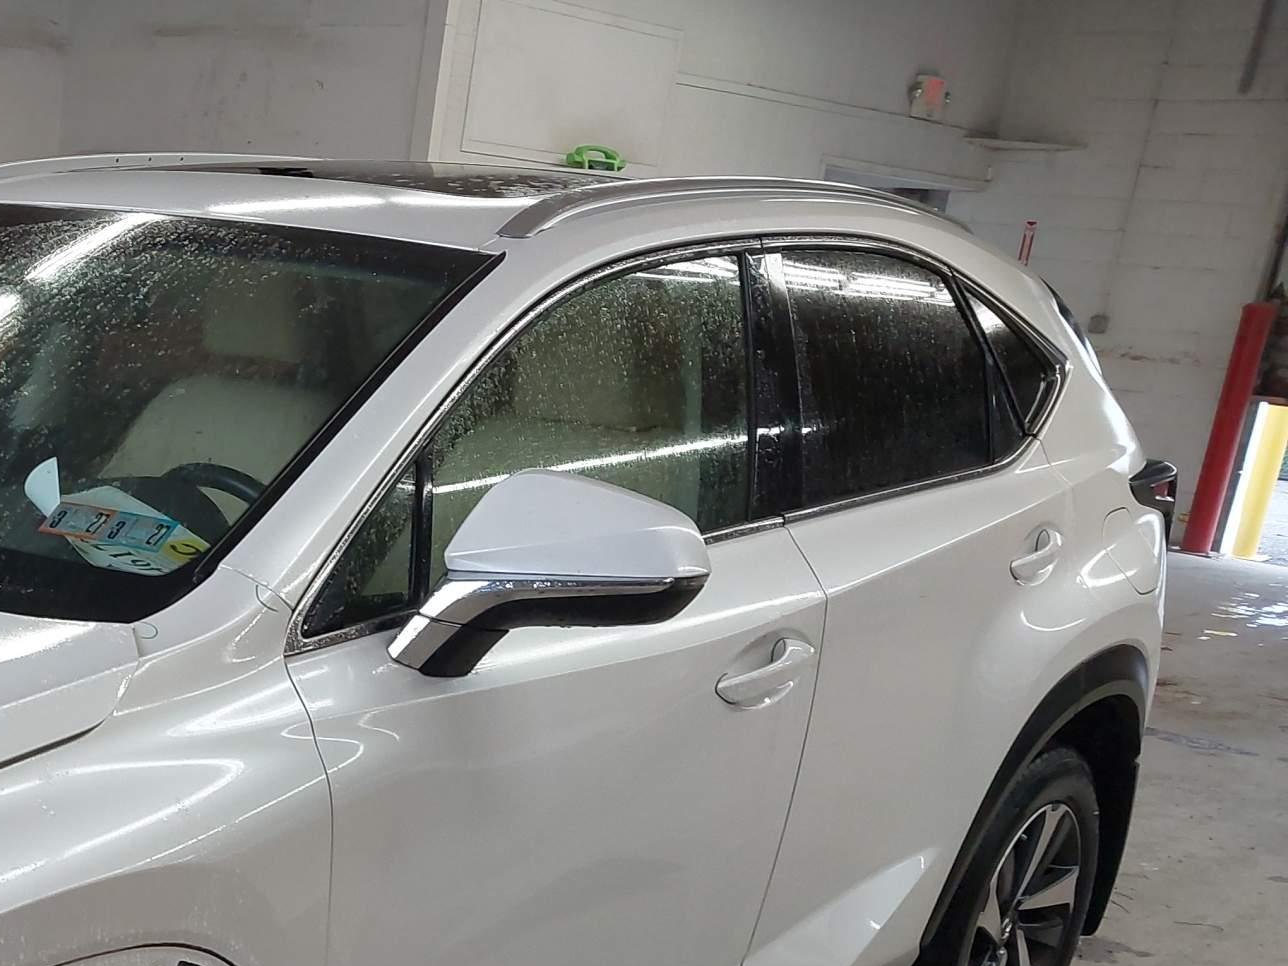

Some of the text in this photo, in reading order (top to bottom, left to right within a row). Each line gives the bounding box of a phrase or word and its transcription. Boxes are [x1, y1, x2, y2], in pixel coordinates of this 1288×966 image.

[49, 509, 171, 547] 3 27 3 27
